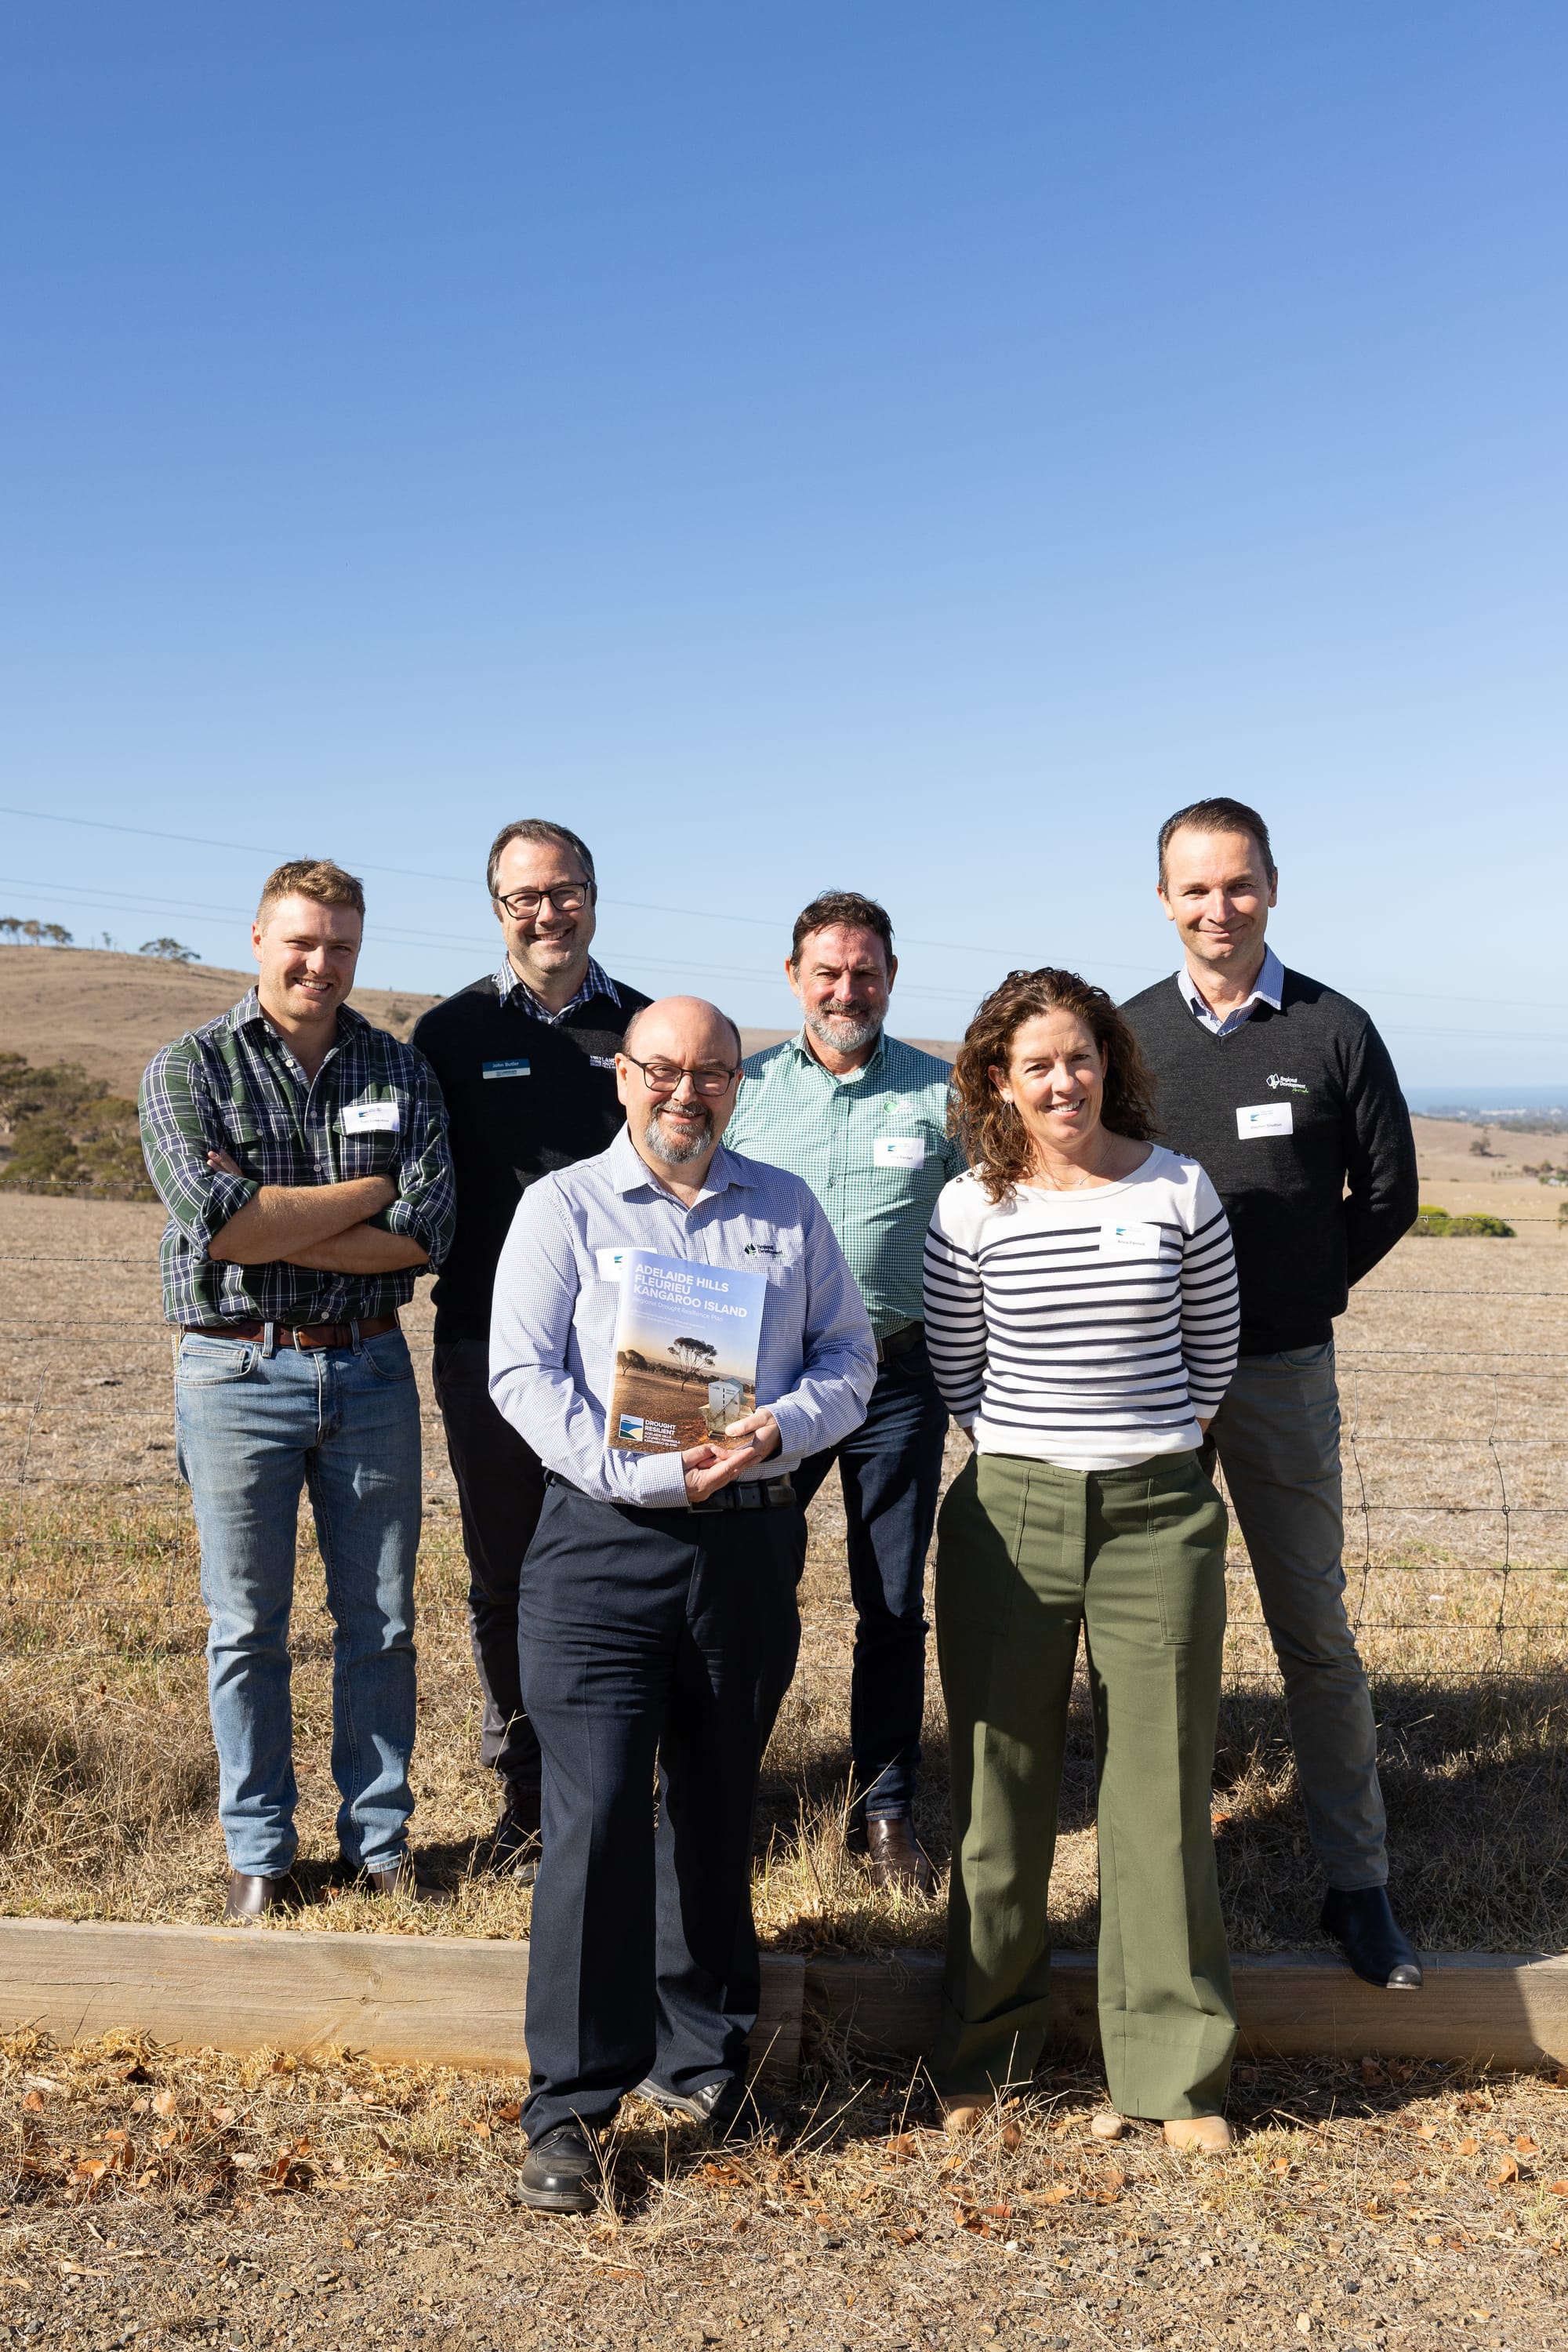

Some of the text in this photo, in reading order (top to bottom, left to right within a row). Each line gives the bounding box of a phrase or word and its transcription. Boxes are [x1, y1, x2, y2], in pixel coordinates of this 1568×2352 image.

[634, 1264, 729, 1293] ADELAIDE HILLS
[634, 1274, 691, 1294] FLEURIEU
[632, 1295, 657, 1306] Regional
[658, 1301, 681, 1313] Drought
[681, 1306, 710, 1319] Resilience
[633, 1284, 747, 1318] KANGAROO ISLAND
[644, 1419, 677, 1430] DROUGHT
[644, 1425, 676, 1436] RESILIENT
